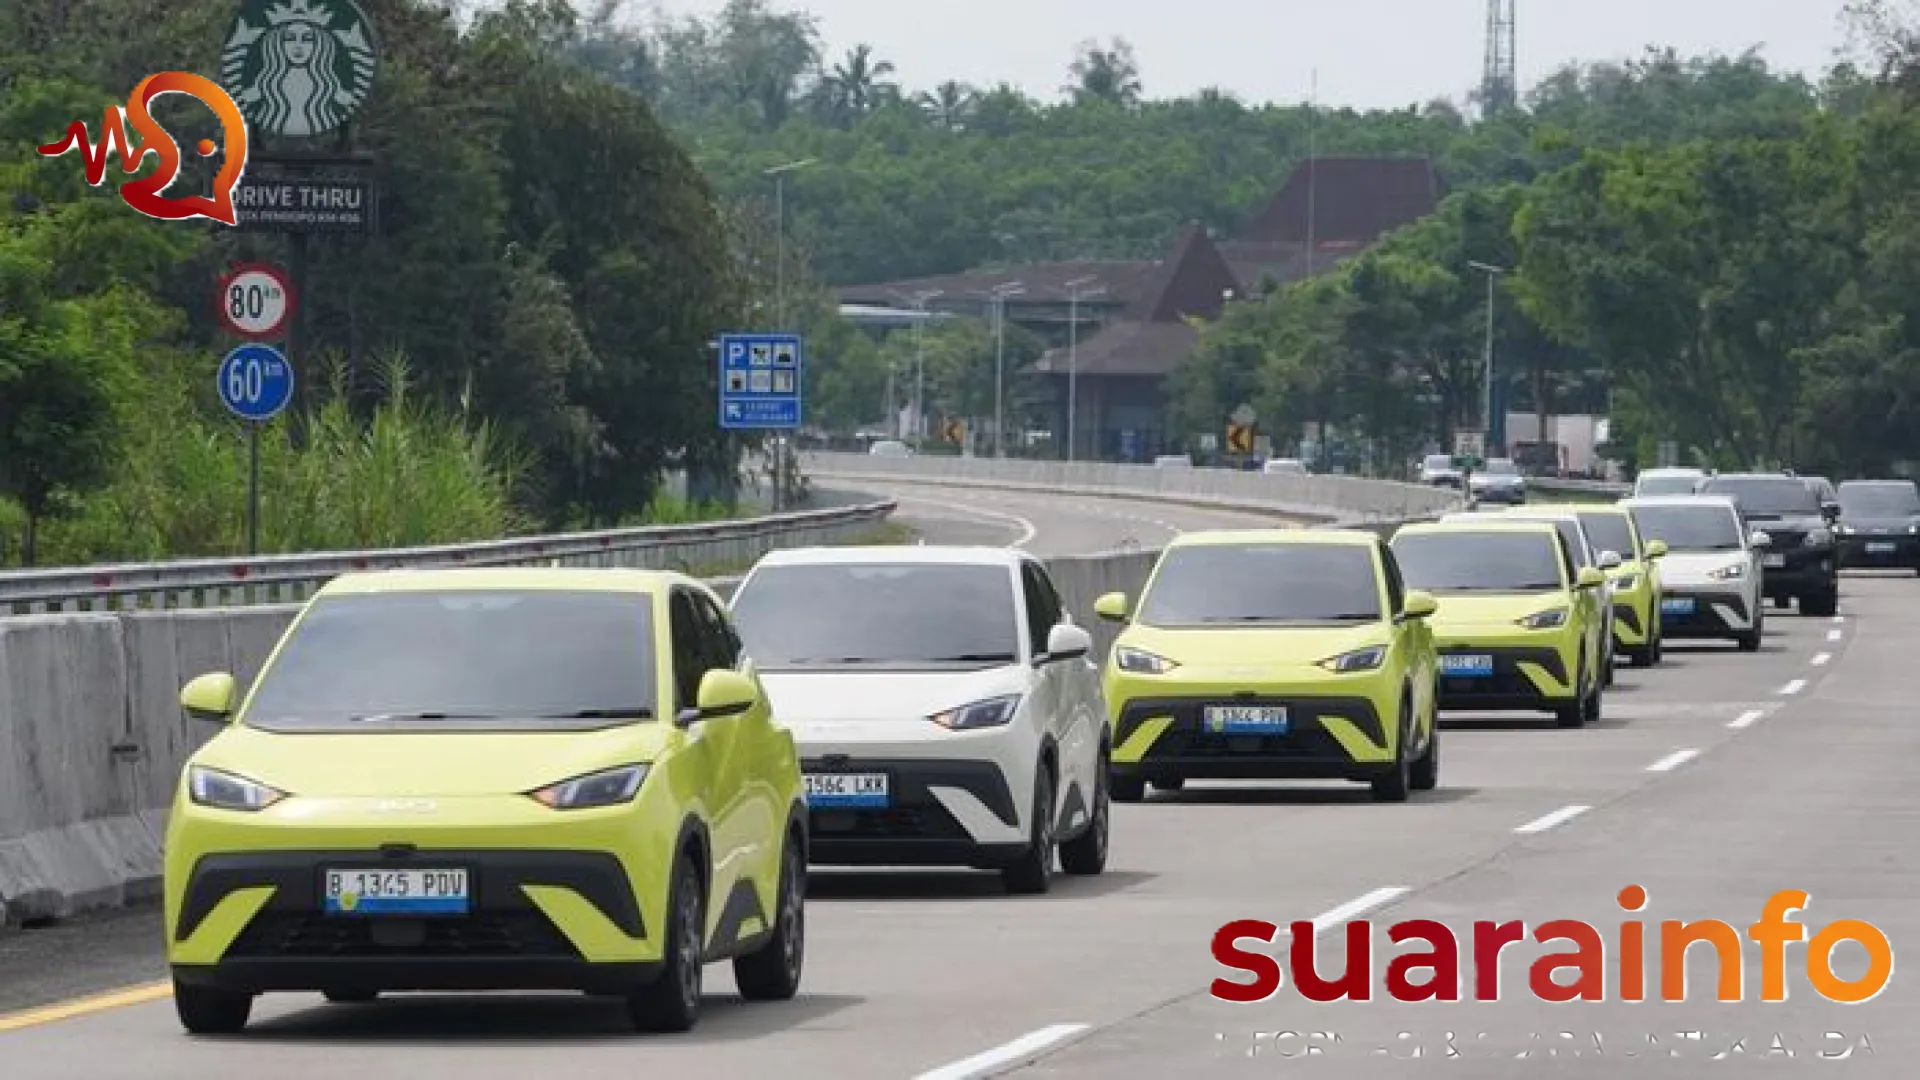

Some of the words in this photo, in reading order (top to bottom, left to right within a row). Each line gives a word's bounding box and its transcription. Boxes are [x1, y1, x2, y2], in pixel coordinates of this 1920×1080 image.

[299, 187, 360, 208] THRU
[230, 285, 264, 318] 80
[729, 342, 744, 365] P
[229, 358, 261, 403] 60
